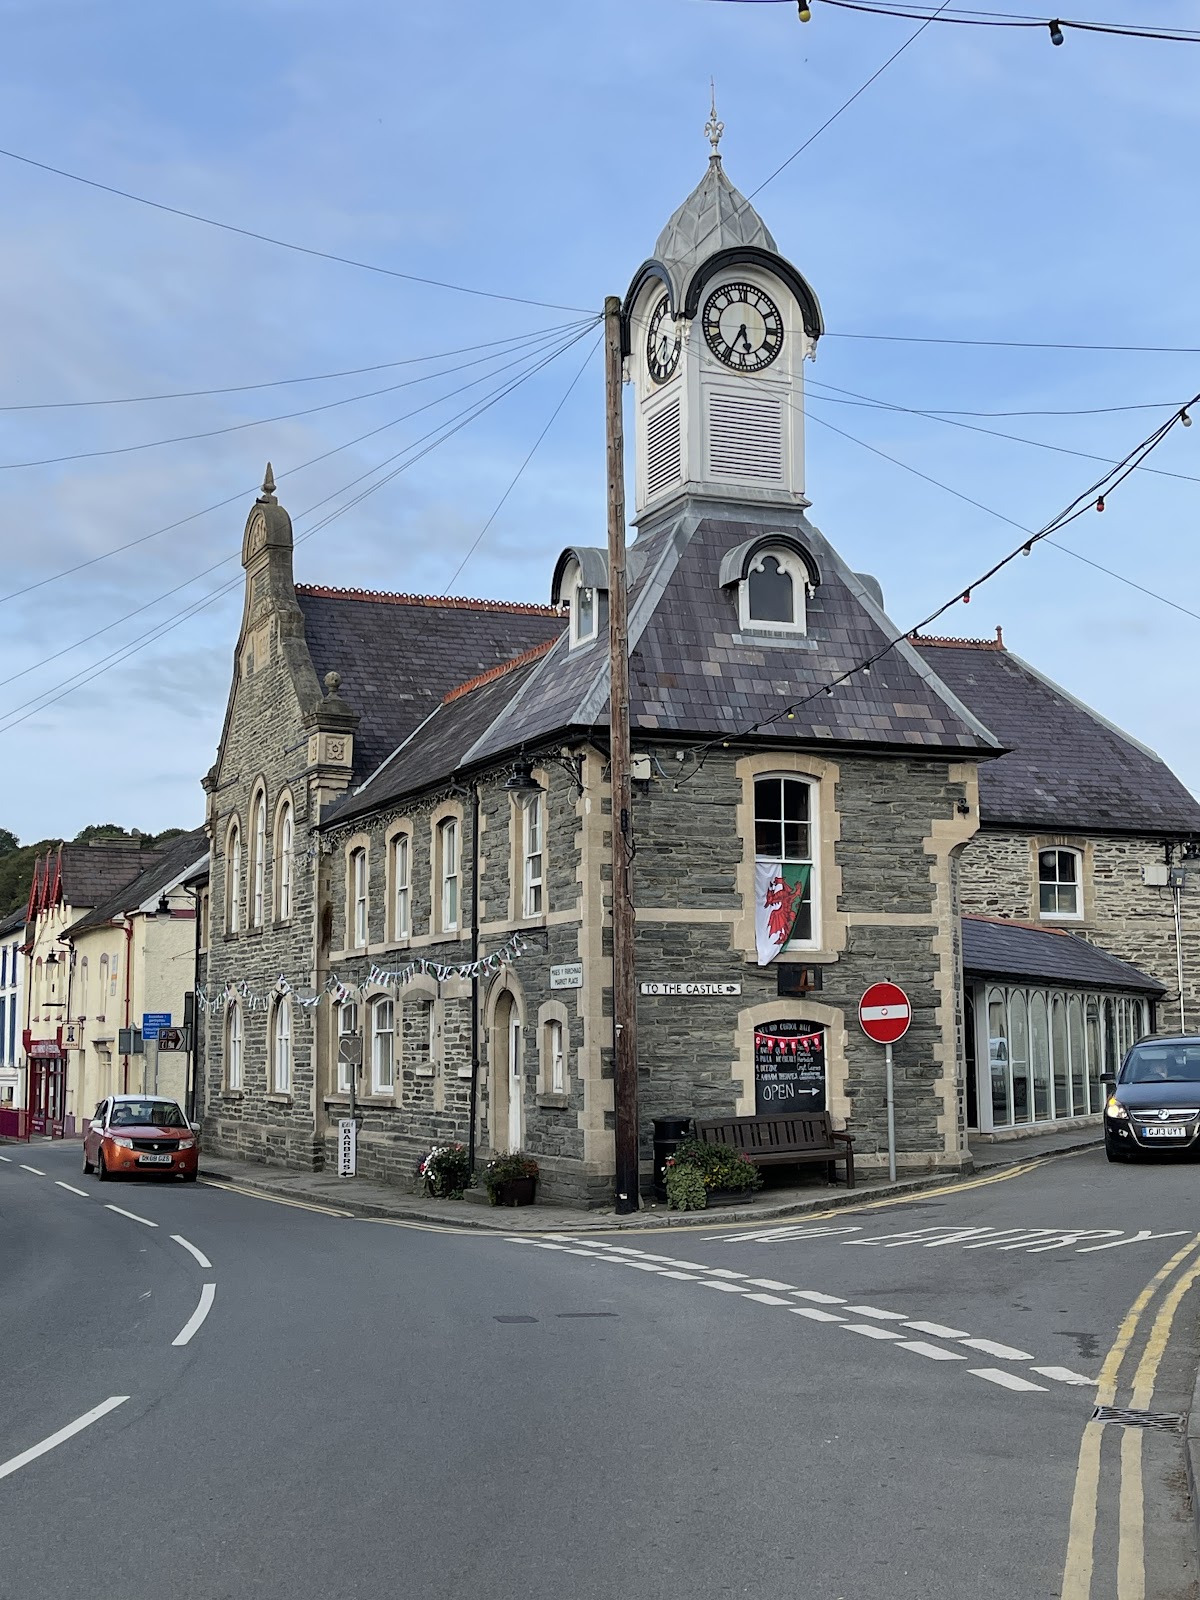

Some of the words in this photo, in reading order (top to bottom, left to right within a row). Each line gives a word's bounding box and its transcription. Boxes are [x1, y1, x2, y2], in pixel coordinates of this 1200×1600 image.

[568, 977, 578, 985] PLACE
[645, 984, 658, 993] TO
[663, 984, 682, 993] THE
[686, 984, 723, 994] CASTLE
[763, 1083, 795, 1101] OPEN
[343, 1128, 351, 1170] BARBERS
[700, 1226, 863, 1243] NO
[840, 1227, 1192, 1253] ENTRY
